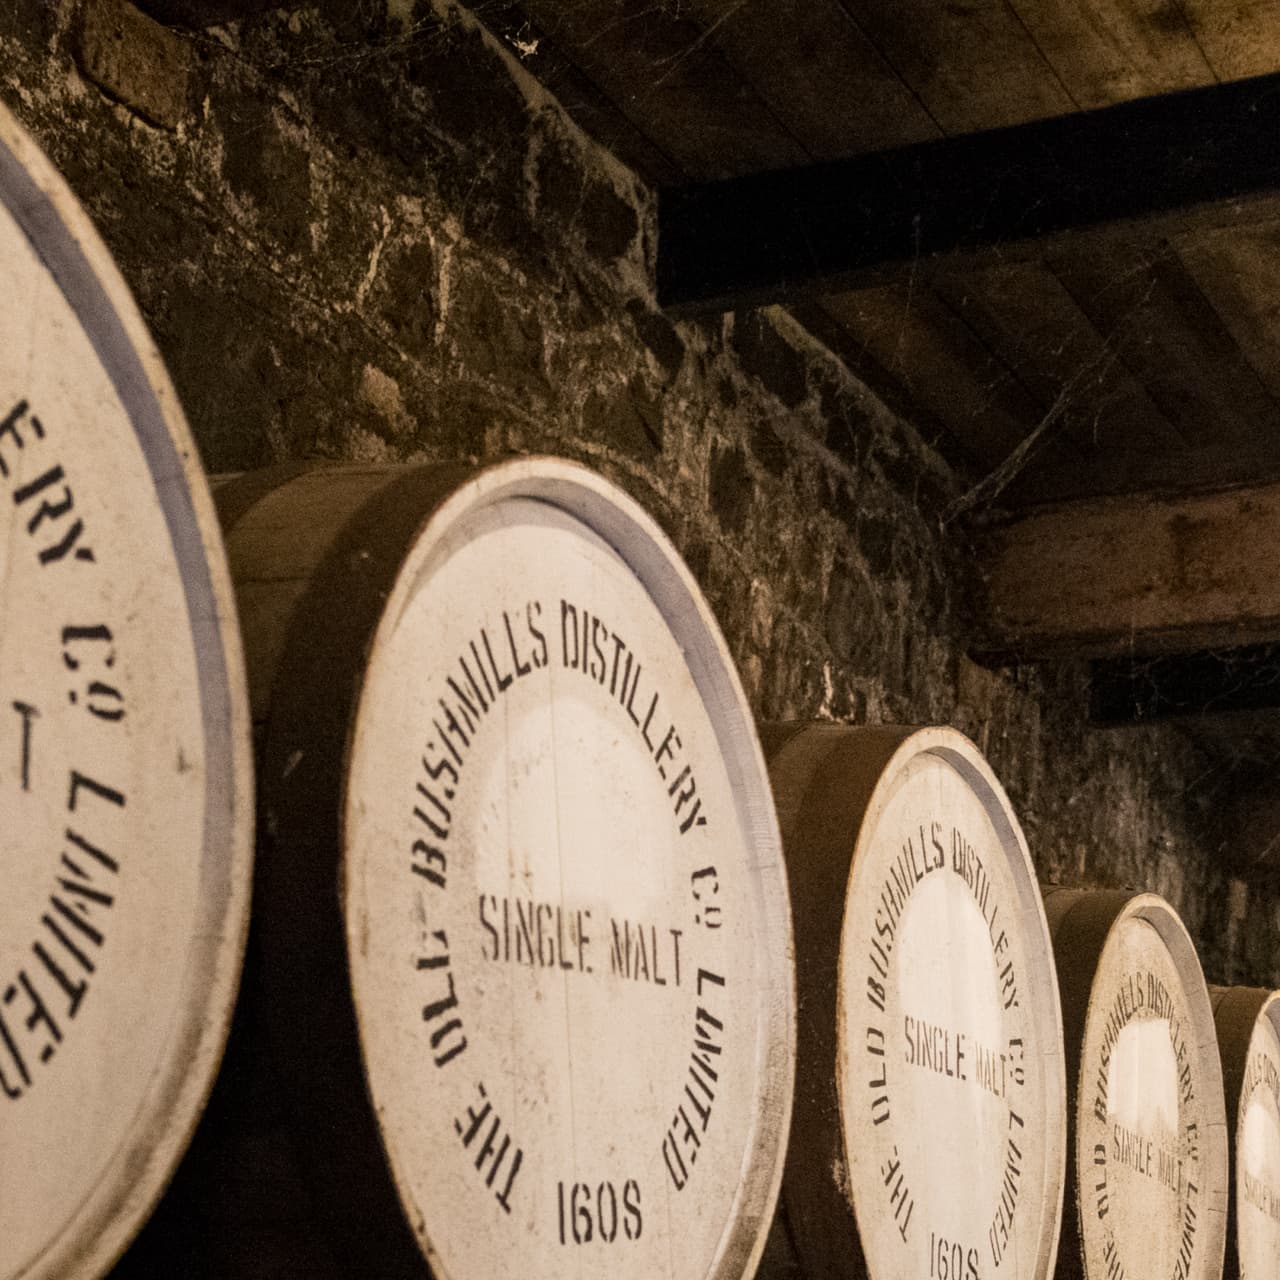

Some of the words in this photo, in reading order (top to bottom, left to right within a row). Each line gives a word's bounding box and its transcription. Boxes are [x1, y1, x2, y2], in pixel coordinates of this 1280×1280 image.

[411, 601, 549, 889] BUSHMILLS
[560, 600, 707, 835] DISTILLERY
[478, 894, 593, 973] SINGLE
[610, 917, 683, 986] MALT
[867, 821, 945, 1012] BUSHMILLS
[953, 827, 1019, 1013] DISTILLERY
[416, 928, 468, 1067] OLD
[904, 1015, 966, 1081] SINGLE
[975, 1040, 1007, 1098] MALT
[661, 968, 725, 1191] LIMITED
[867, 1028, 891, 1126] OLD
[454, 1083, 524, 1214] THE
[881, 1146, 914, 1243] THE
[990, 1110, 1024, 1267] LIMITED
[1093, 1143, 1110, 1220] OLD
[1113, 1124, 1152, 1178] SINGLE
